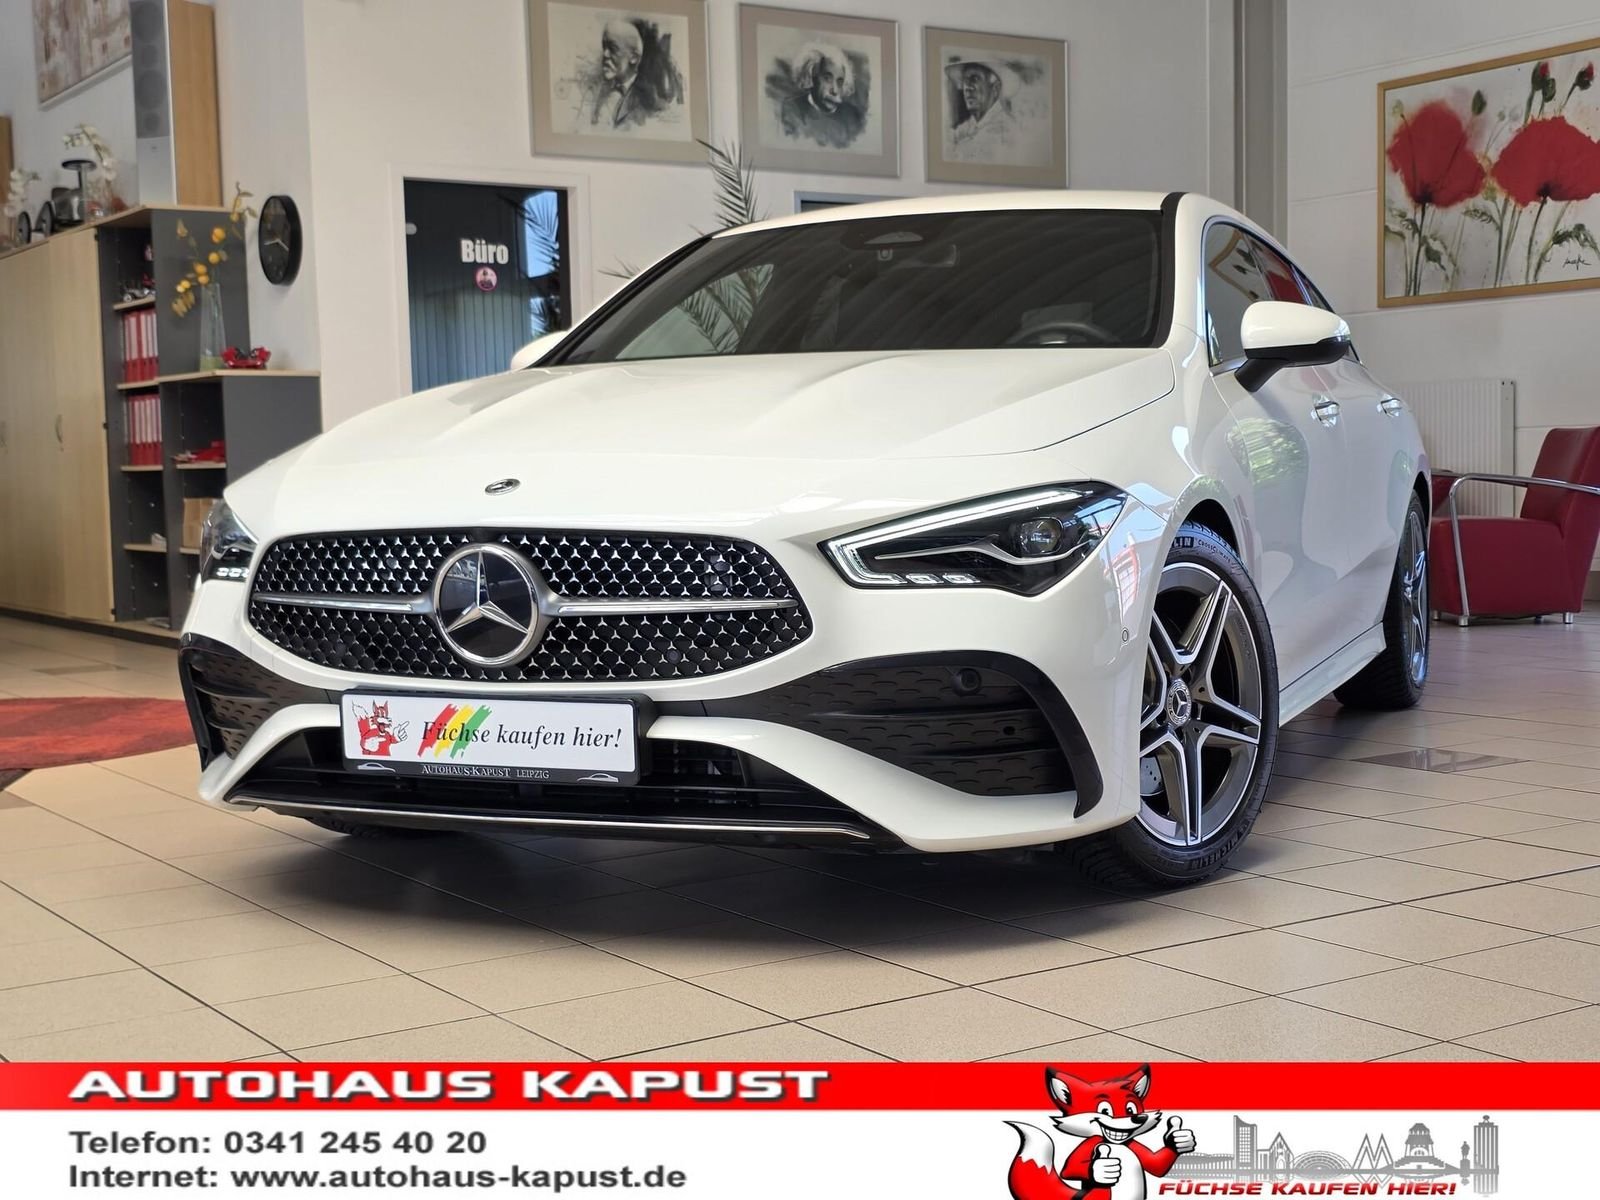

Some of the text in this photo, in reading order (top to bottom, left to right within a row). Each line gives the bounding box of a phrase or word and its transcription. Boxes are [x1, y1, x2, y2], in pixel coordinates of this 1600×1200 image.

[461, 239, 509, 265] Büro
[422, 721, 622, 750] Füchse kaufen hier!
[516, 769, 550, 779] LEIPZIG
